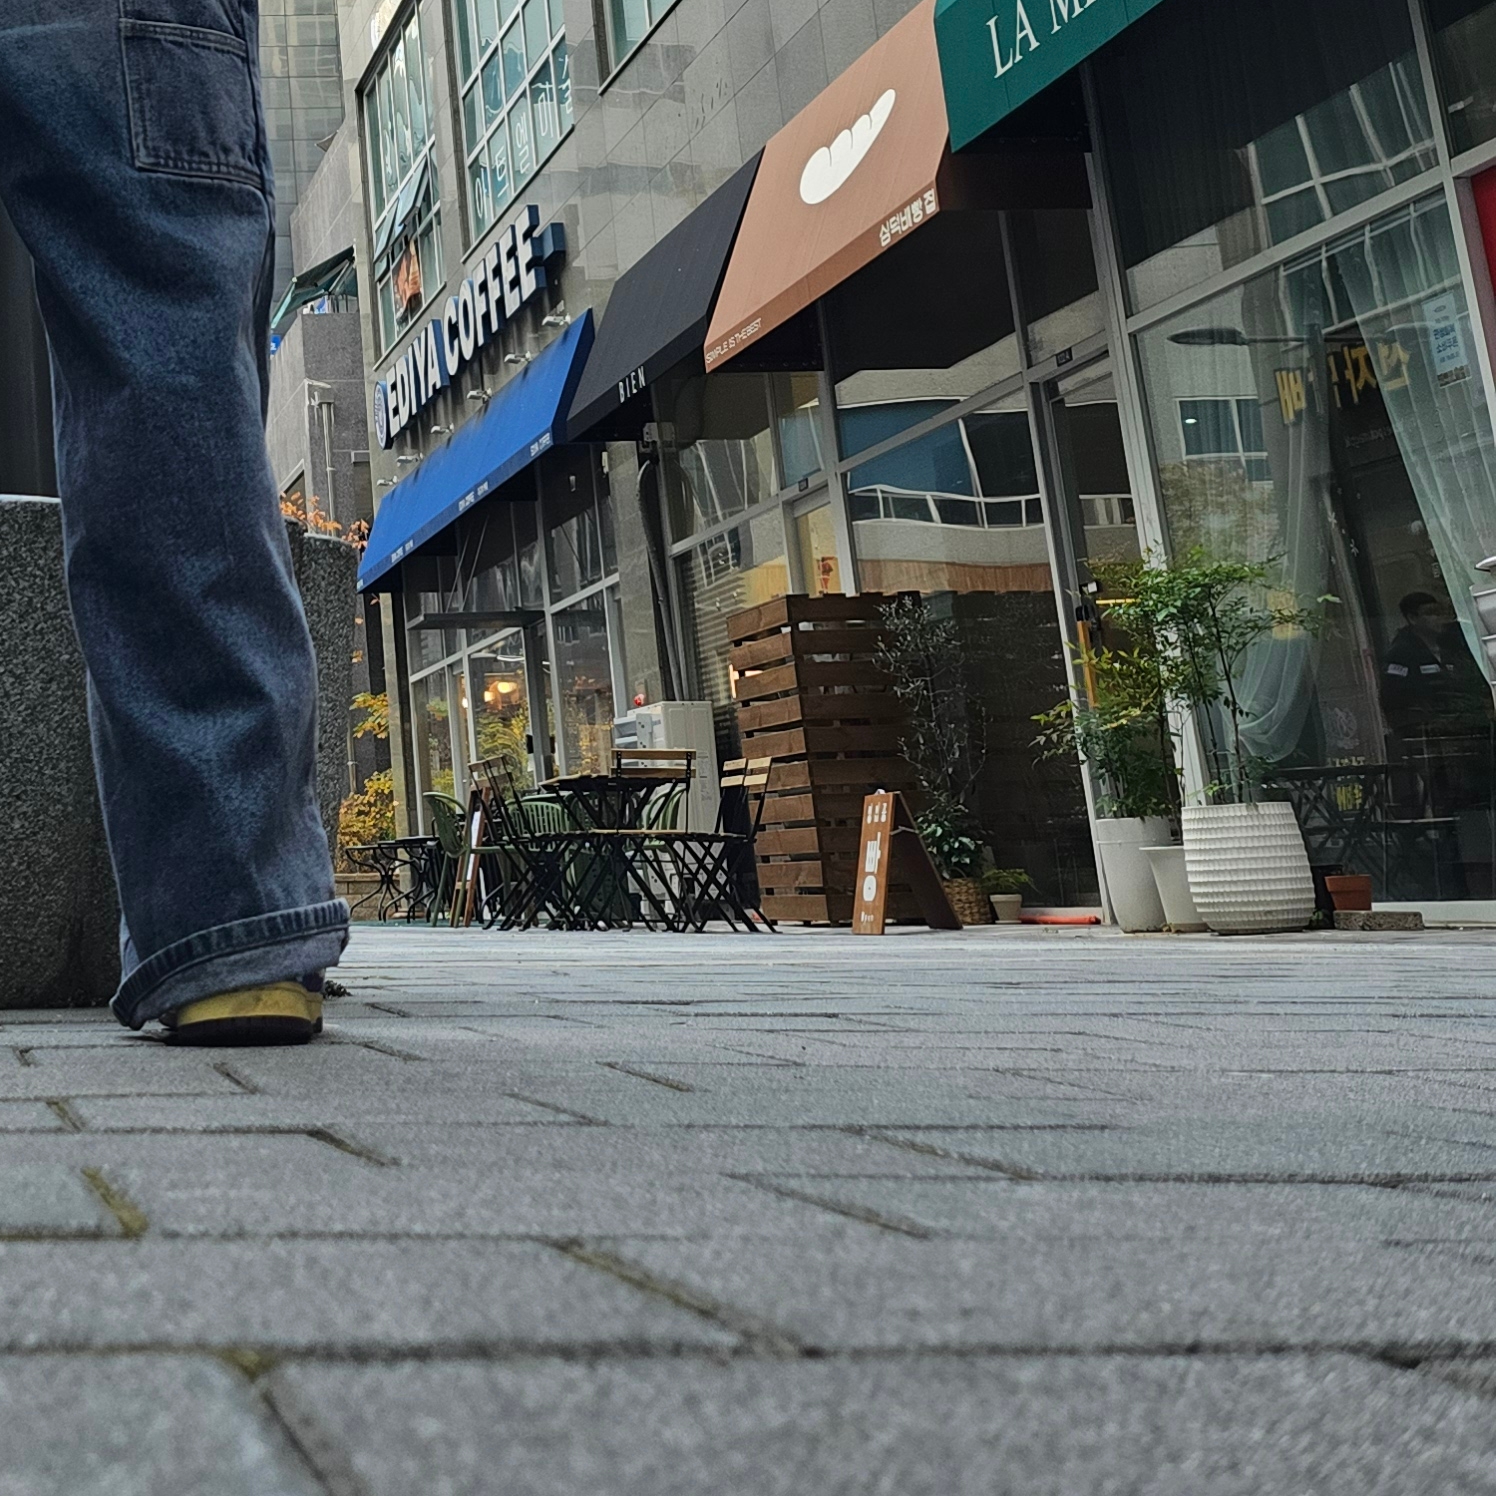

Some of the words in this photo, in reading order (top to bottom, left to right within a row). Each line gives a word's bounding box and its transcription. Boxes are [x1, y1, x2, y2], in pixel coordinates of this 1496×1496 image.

[385, 319, 447, 439] EDIYA
[444, 204, 546, 376] COFFEE
[618, 365, 646, 404] BIEN
